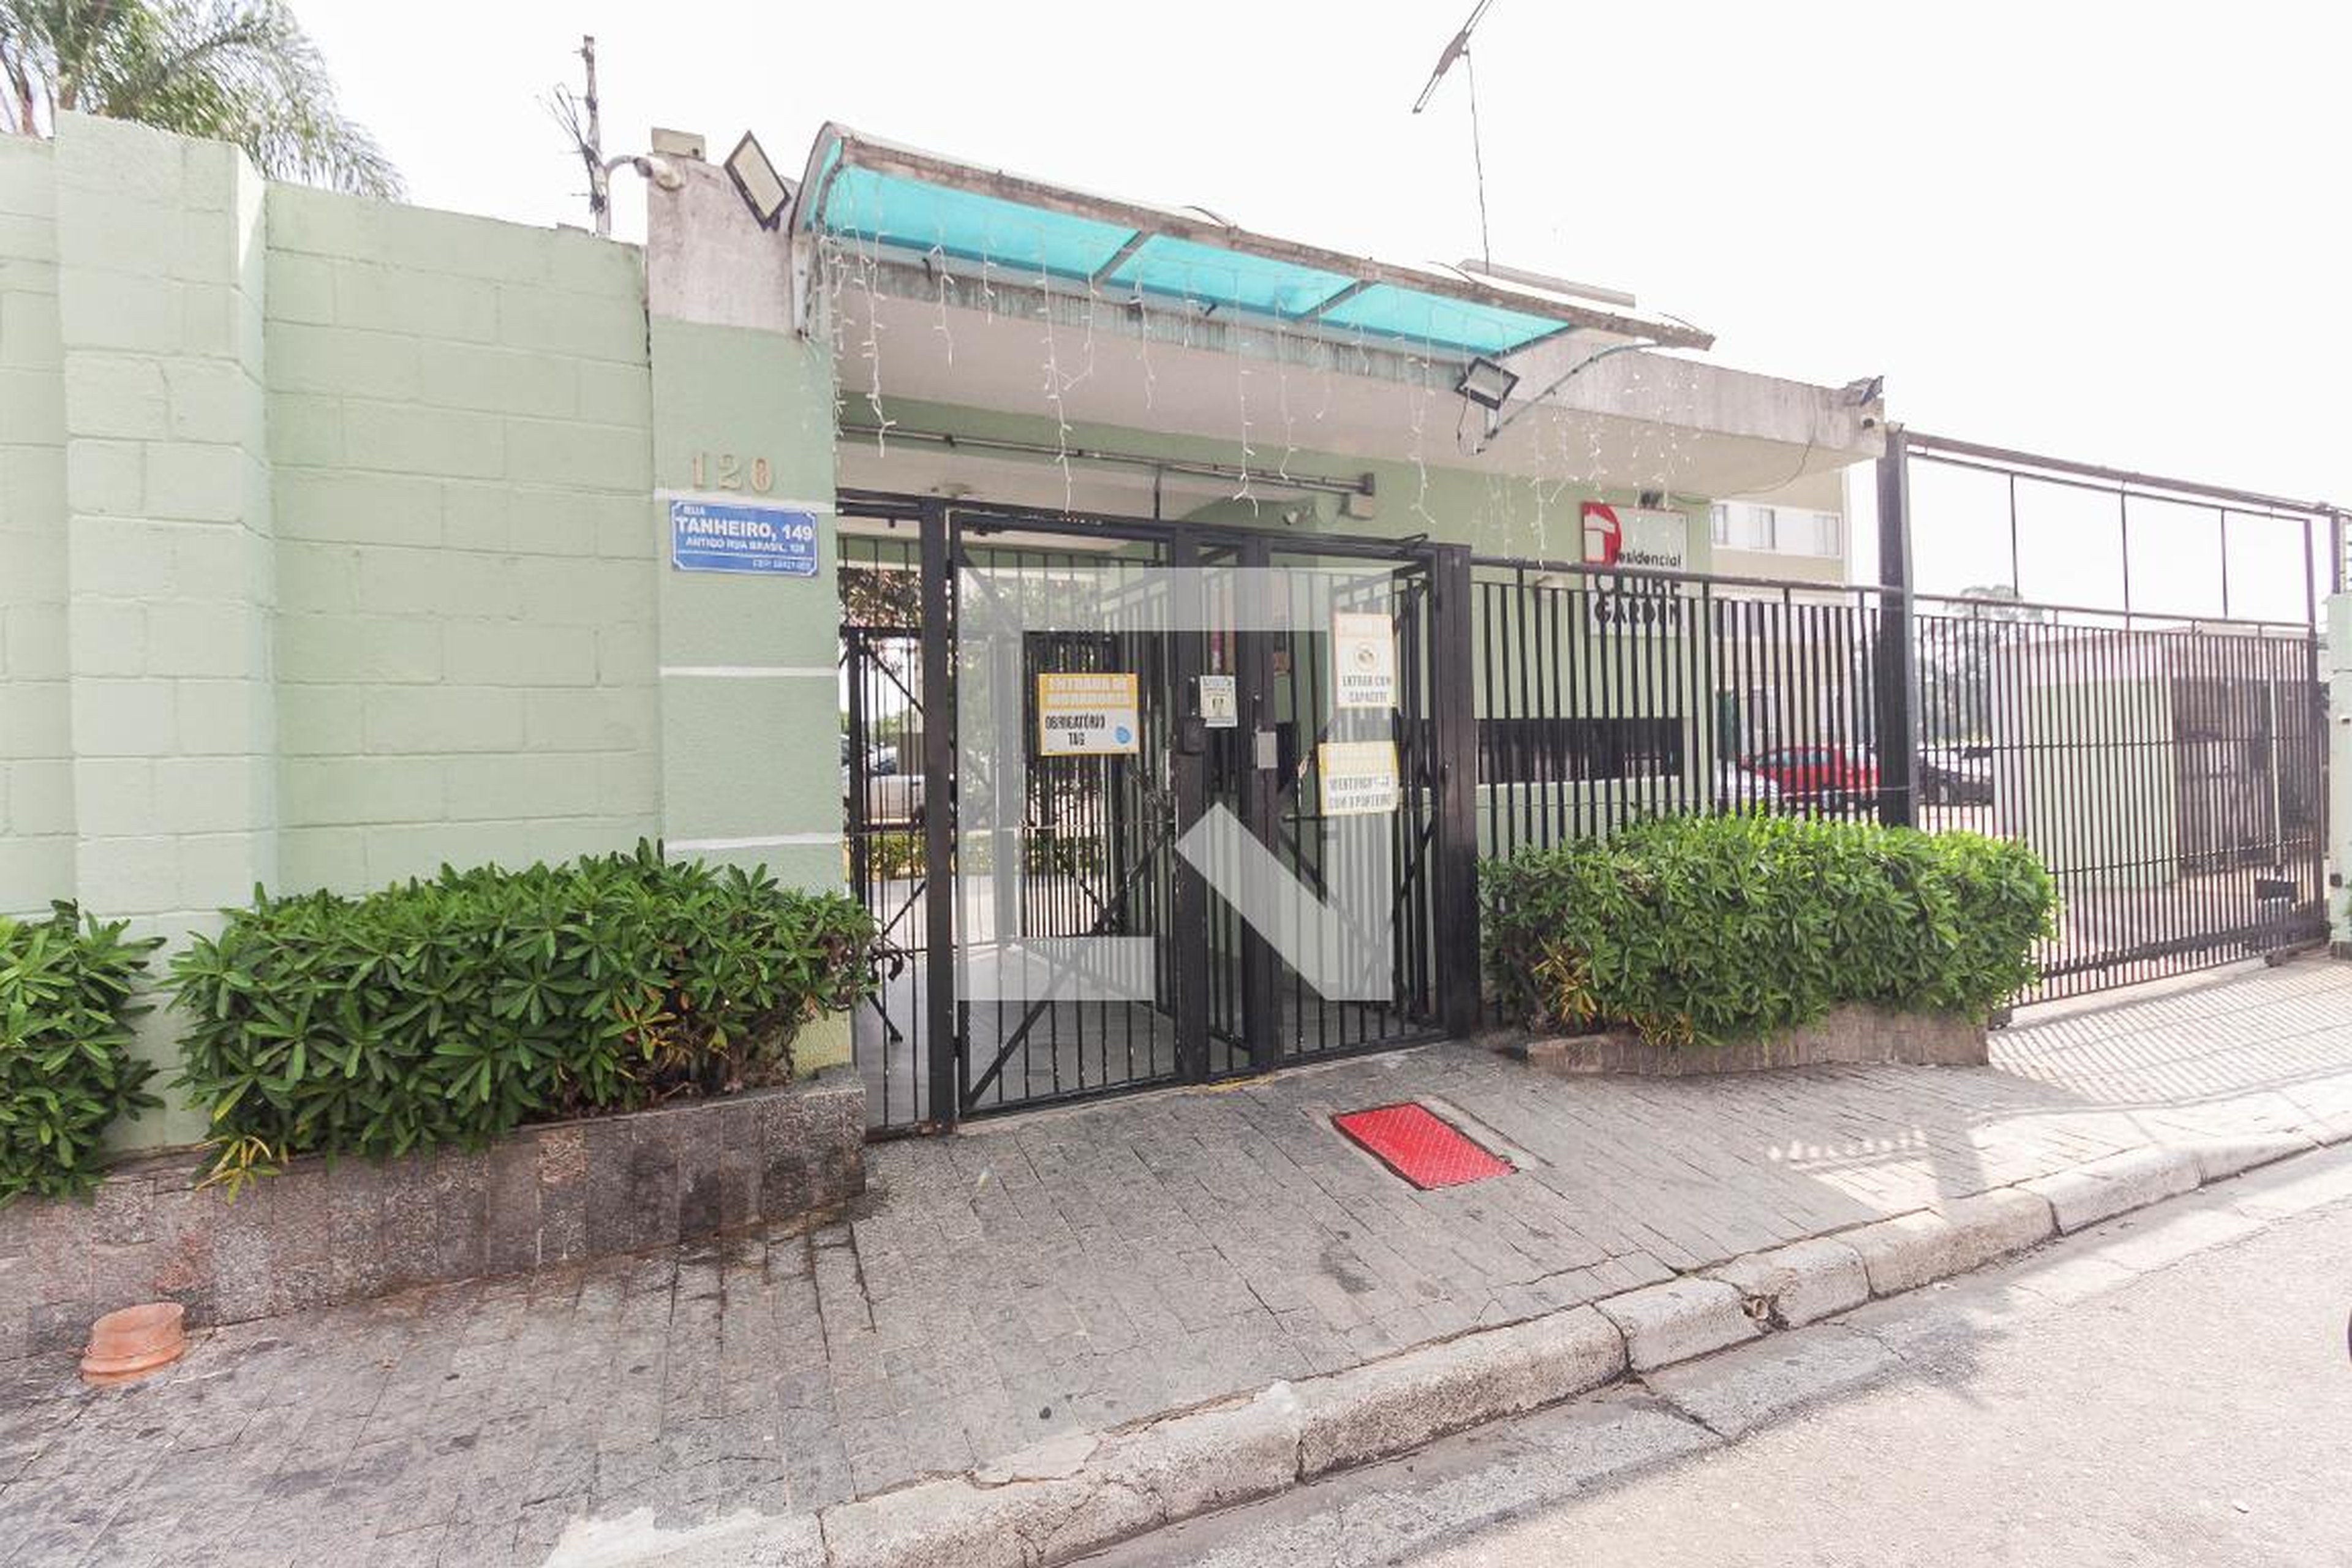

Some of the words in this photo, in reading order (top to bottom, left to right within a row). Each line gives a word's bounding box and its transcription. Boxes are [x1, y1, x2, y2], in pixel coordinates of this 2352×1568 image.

[693, 453, 772, 492] 120
[683, 505, 706, 514] RUA
[676, 517, 777, 541] TANHEIRO,
[782, 525, 813, 541] 149
[1068, 732, 1086, 746] TAG
